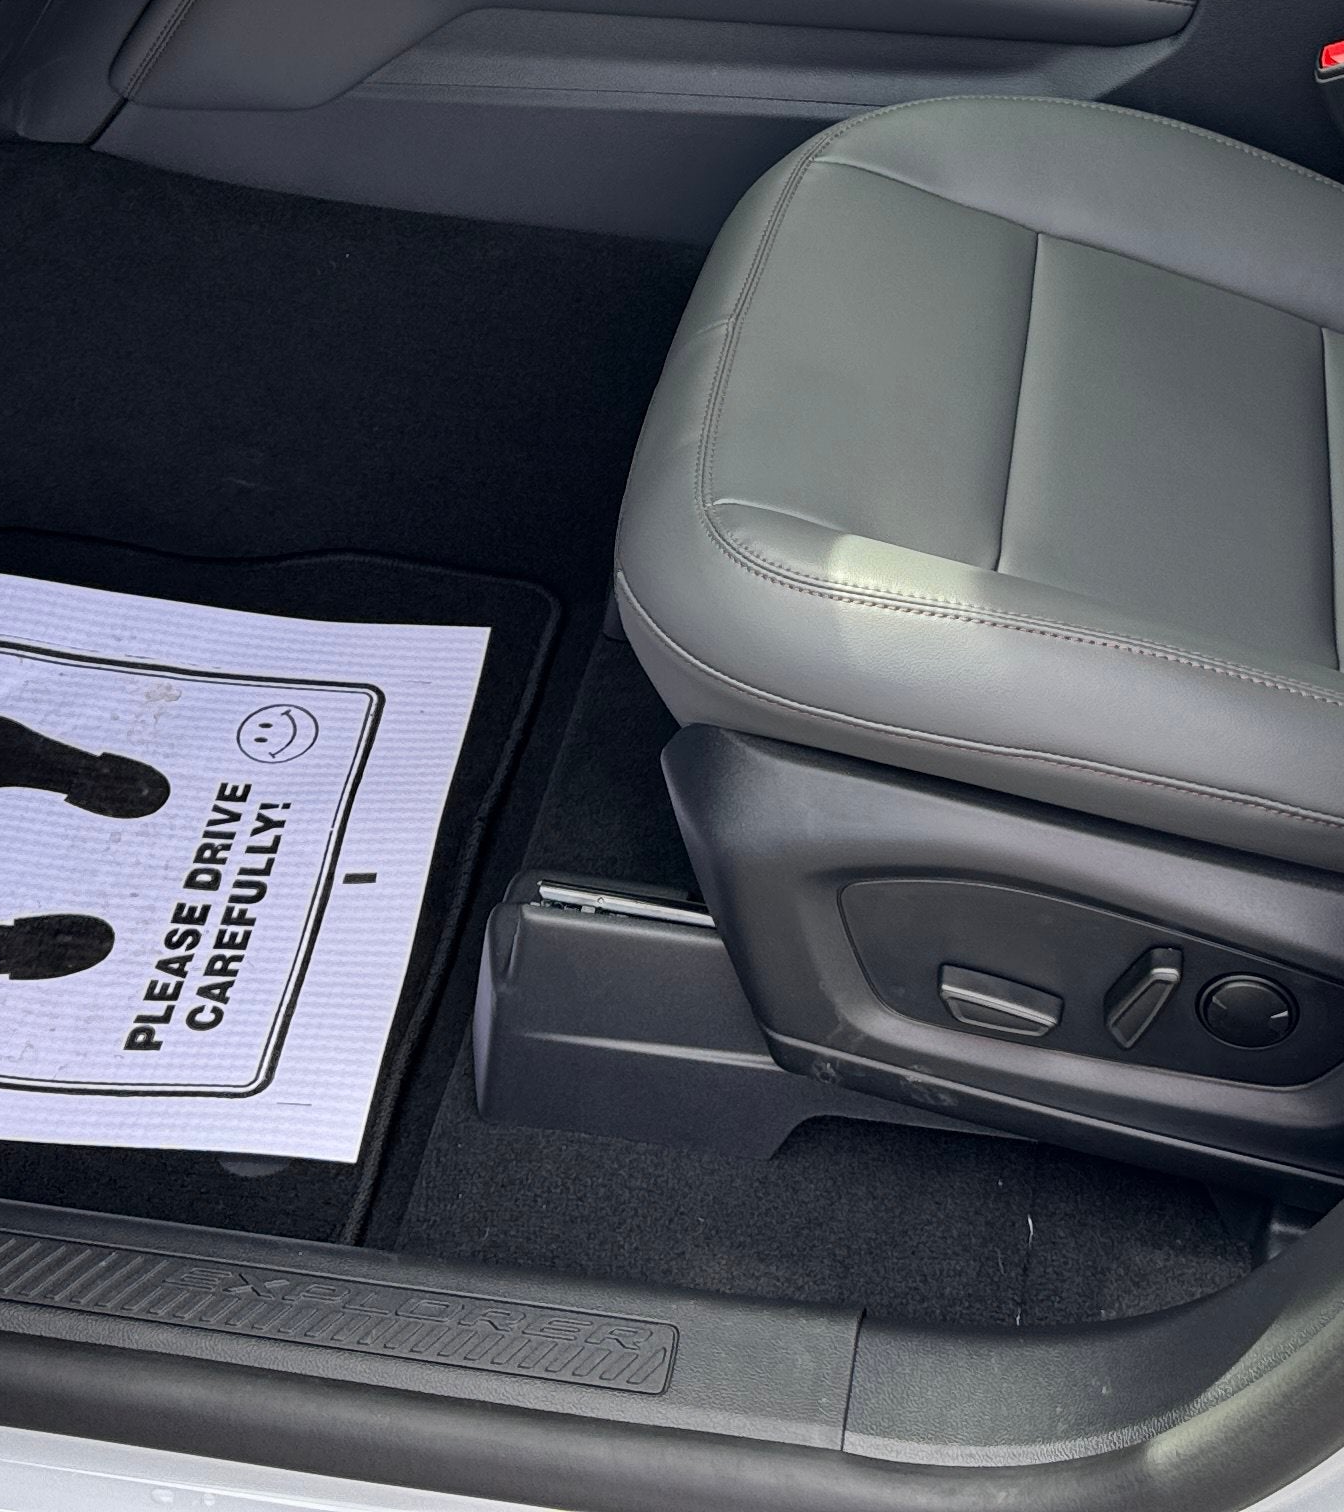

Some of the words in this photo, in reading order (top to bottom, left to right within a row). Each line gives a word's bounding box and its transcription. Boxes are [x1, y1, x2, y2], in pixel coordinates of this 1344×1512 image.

[123, 902, 212, 1051] PLEASE
[182, 782, 252, 891] DRIVE
[185, 802, 292, 1031] CAREFULLY!
[162, 1265, 654, 1351] EXPLORER
